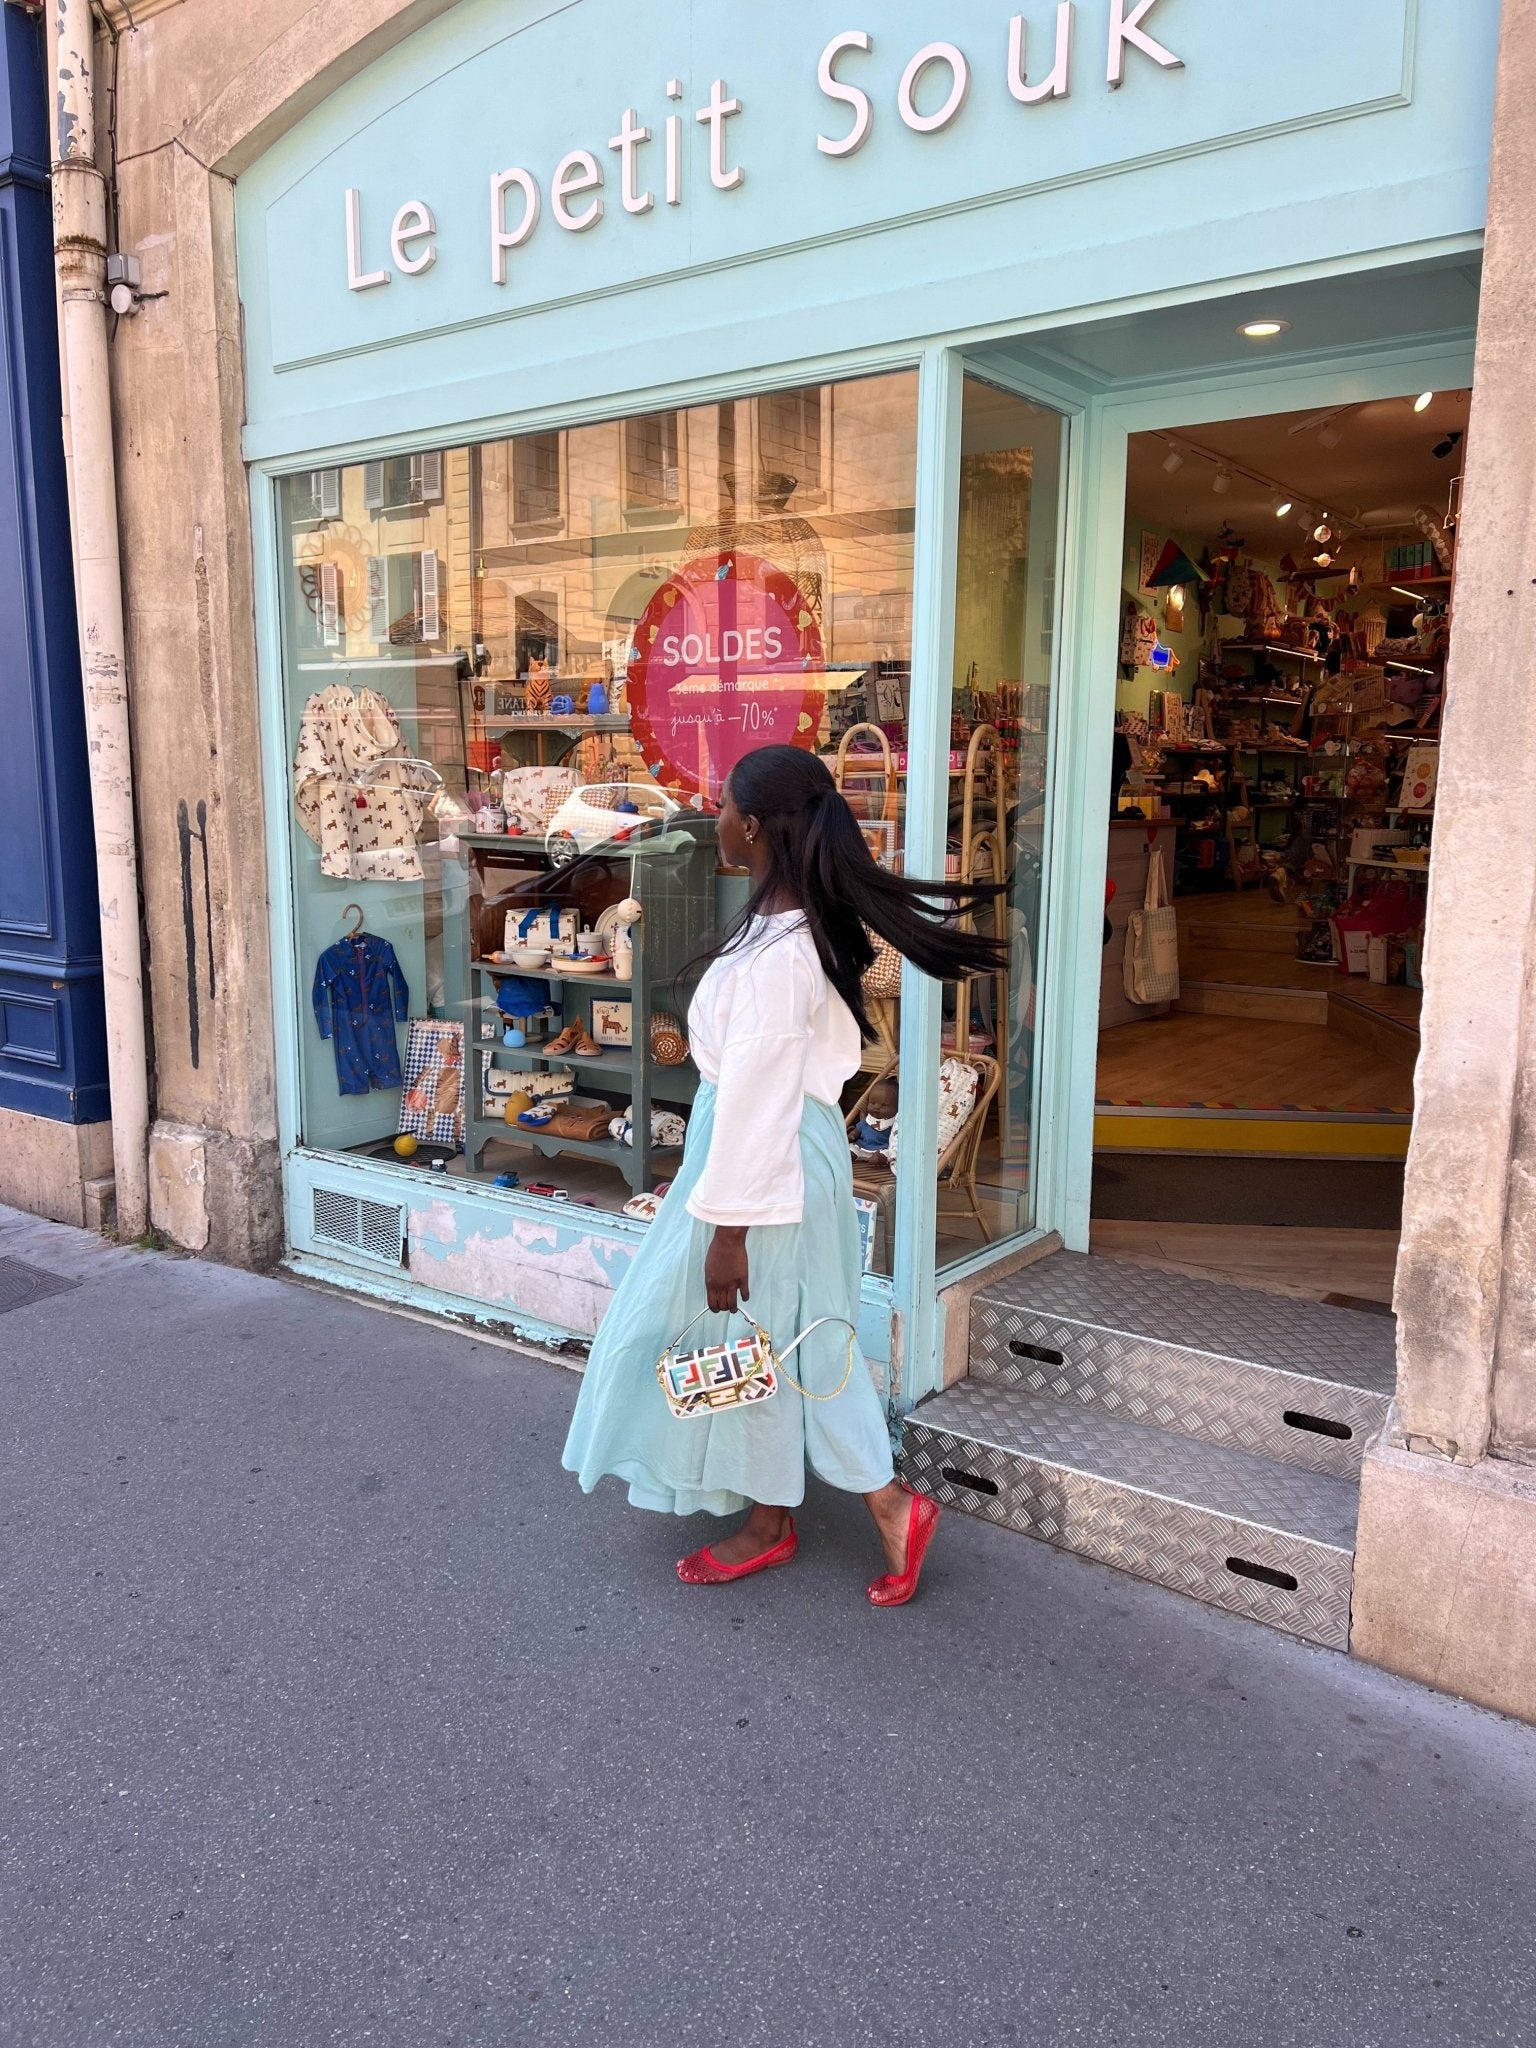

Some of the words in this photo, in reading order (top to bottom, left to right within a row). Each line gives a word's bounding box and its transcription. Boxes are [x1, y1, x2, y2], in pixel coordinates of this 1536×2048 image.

[345, 187, 437, 293] Le
[490, 79, 745, 286] petit
[662, 626, 783, 667] SOLDES
[709, 679, 769, 694] démarque
[670, 707, 725, 737] jusqu'à
